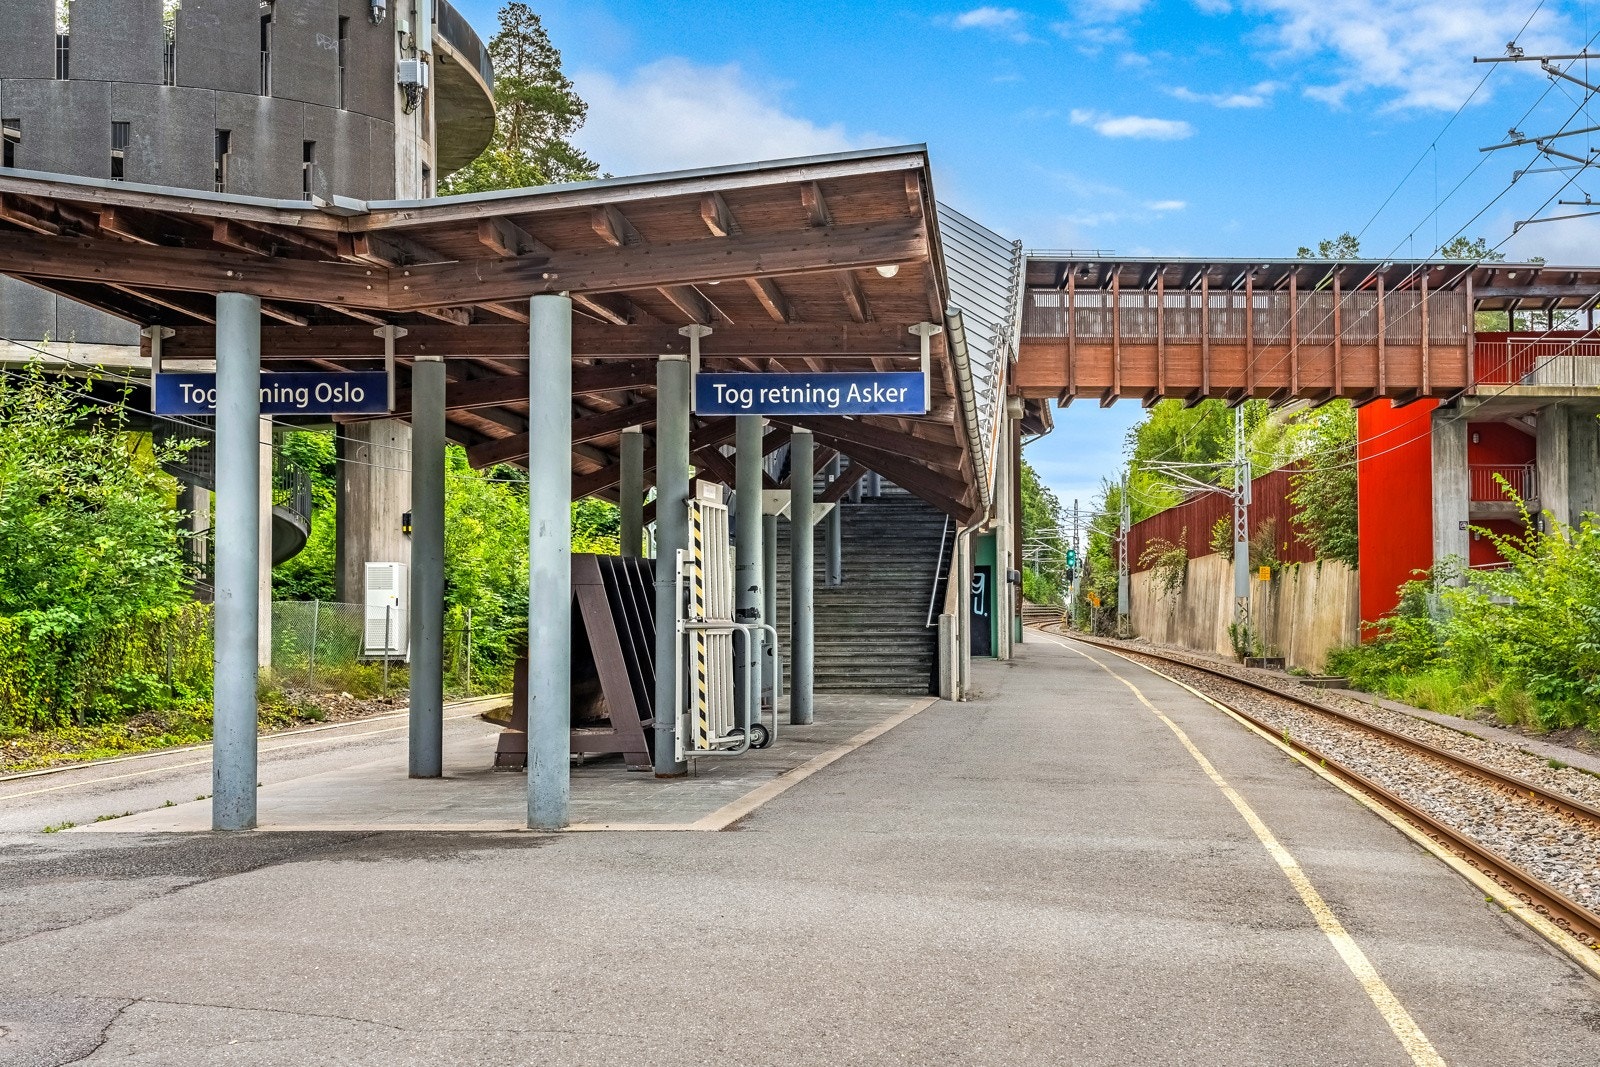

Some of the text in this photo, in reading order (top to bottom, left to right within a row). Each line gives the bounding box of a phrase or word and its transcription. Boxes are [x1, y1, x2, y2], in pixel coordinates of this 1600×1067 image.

[179, 381, 365, 409] Tog ning Oslo
[712, 382, 908, 409] Tog retning Asker
